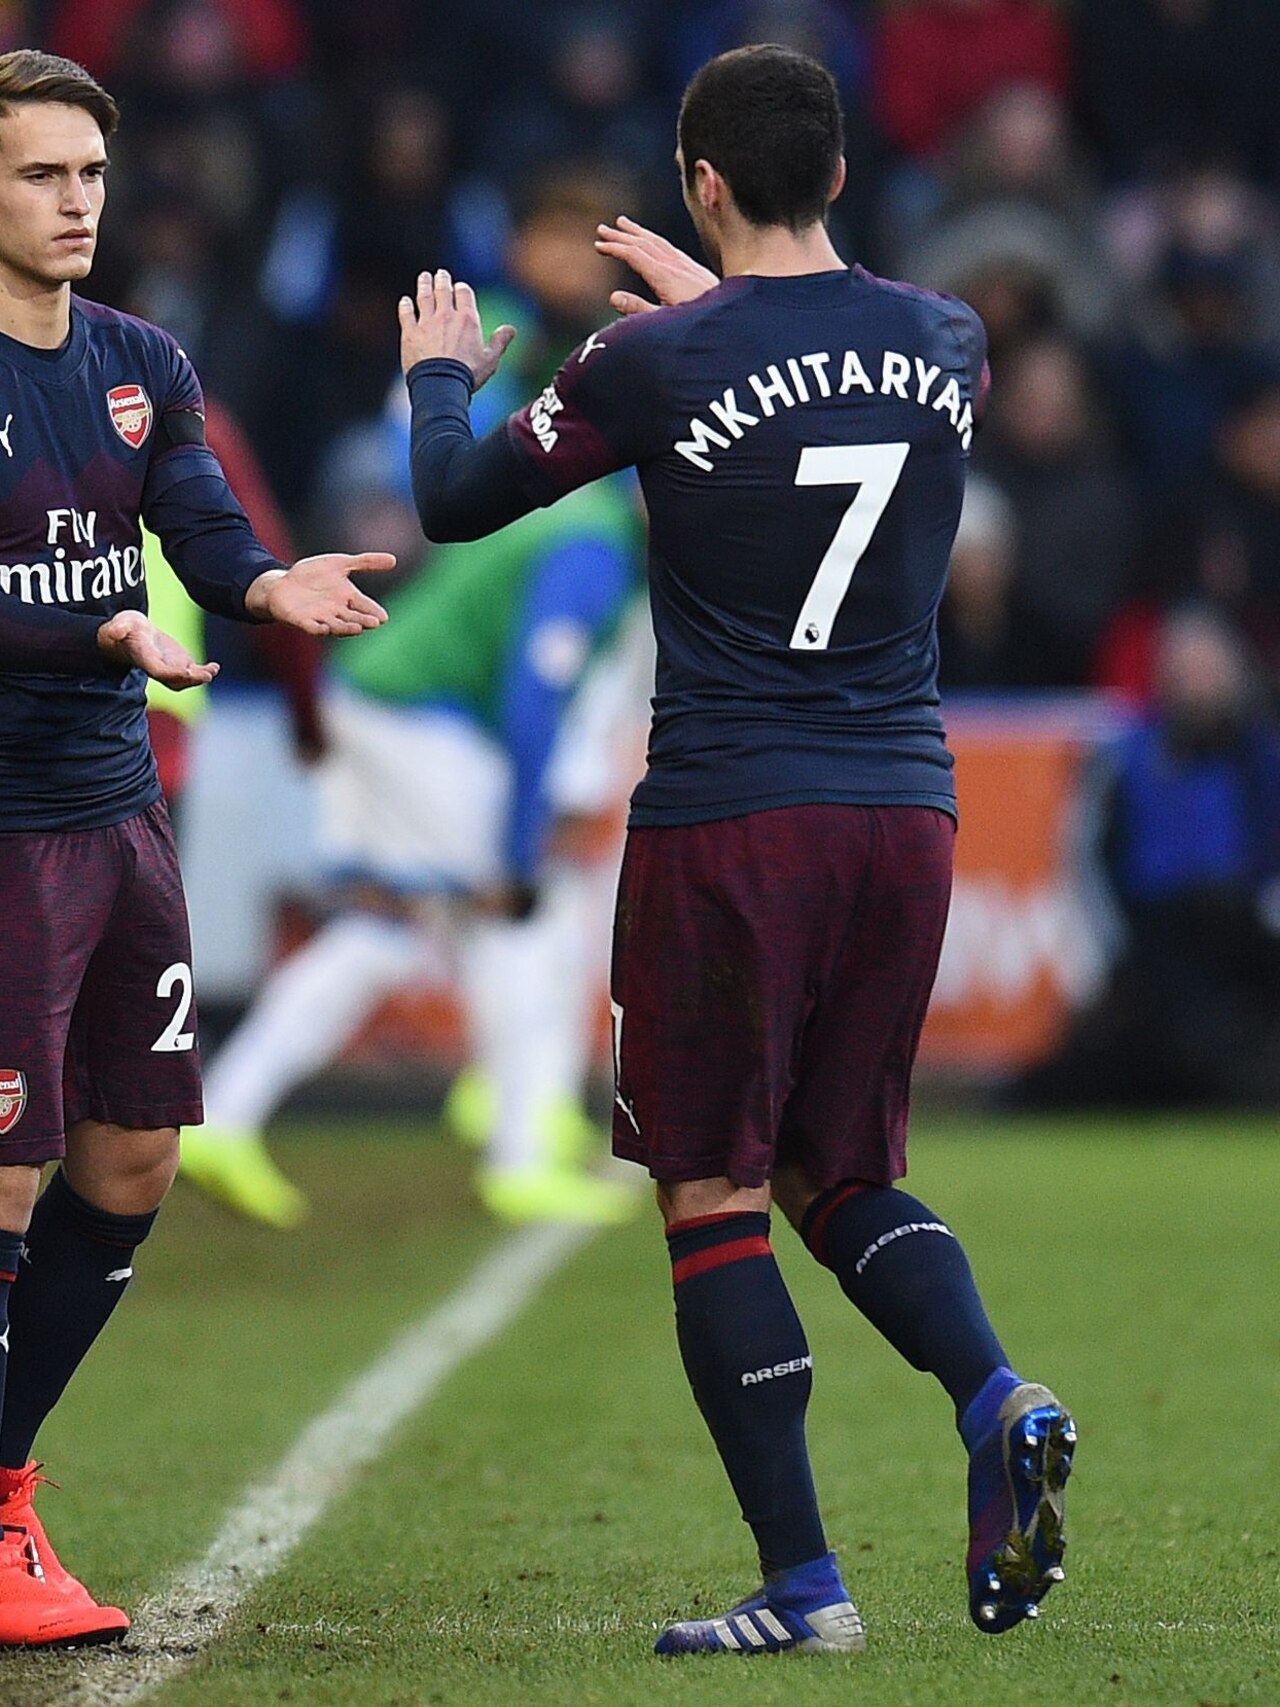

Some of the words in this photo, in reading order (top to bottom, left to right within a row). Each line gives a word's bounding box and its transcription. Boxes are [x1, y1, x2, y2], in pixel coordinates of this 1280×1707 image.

[46, 507, 97, 548] Fly
[788, 441, 911, 650] 7
[741, 1354, 813, 1387] ARSEN
